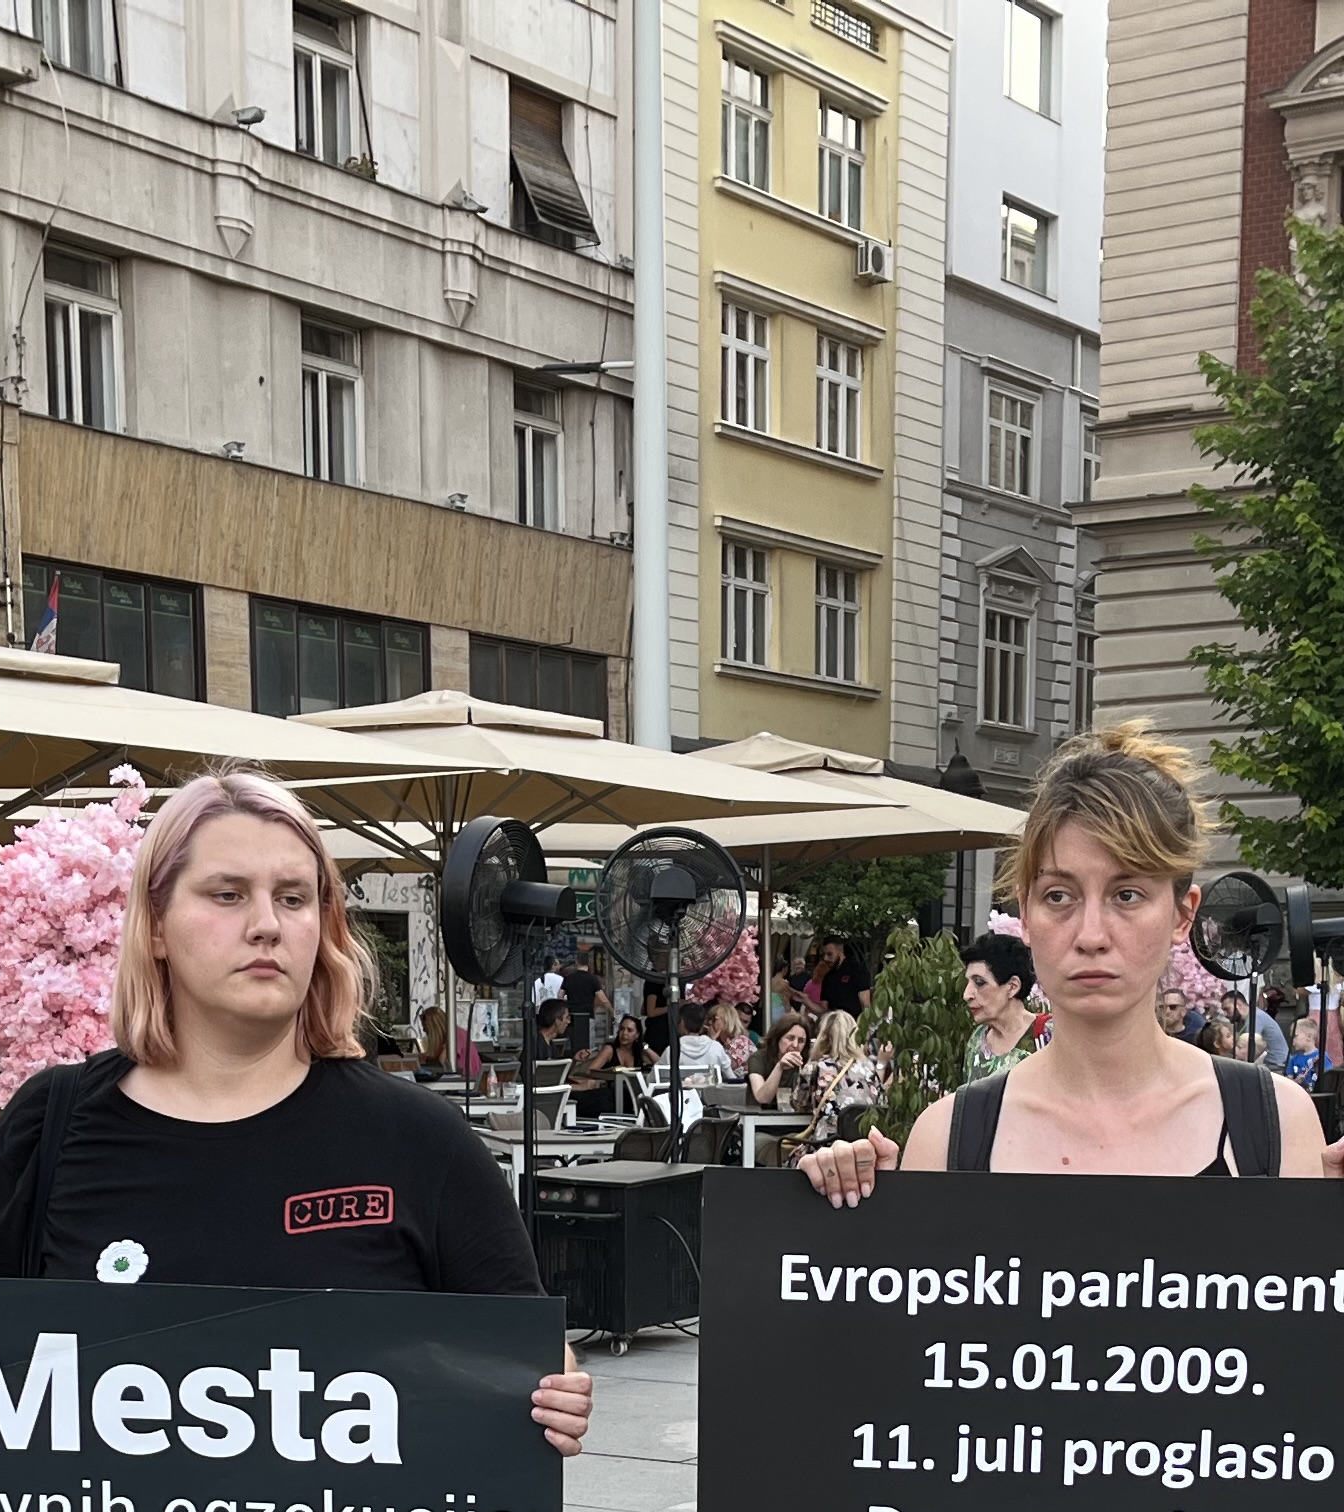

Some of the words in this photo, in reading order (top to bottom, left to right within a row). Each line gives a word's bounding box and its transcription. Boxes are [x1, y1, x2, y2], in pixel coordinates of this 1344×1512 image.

[293, 1193, 385, 1224] CURE
[780, 1254, 1021, 1316] Evropski
[923, 1342, 1265, 1396] 15.01.2009.
[852, 1423, 935, 1471] 11.
[951, 1424, 1043, 1483] juli
[1063, 1429, 1335, 1489] proglasio
